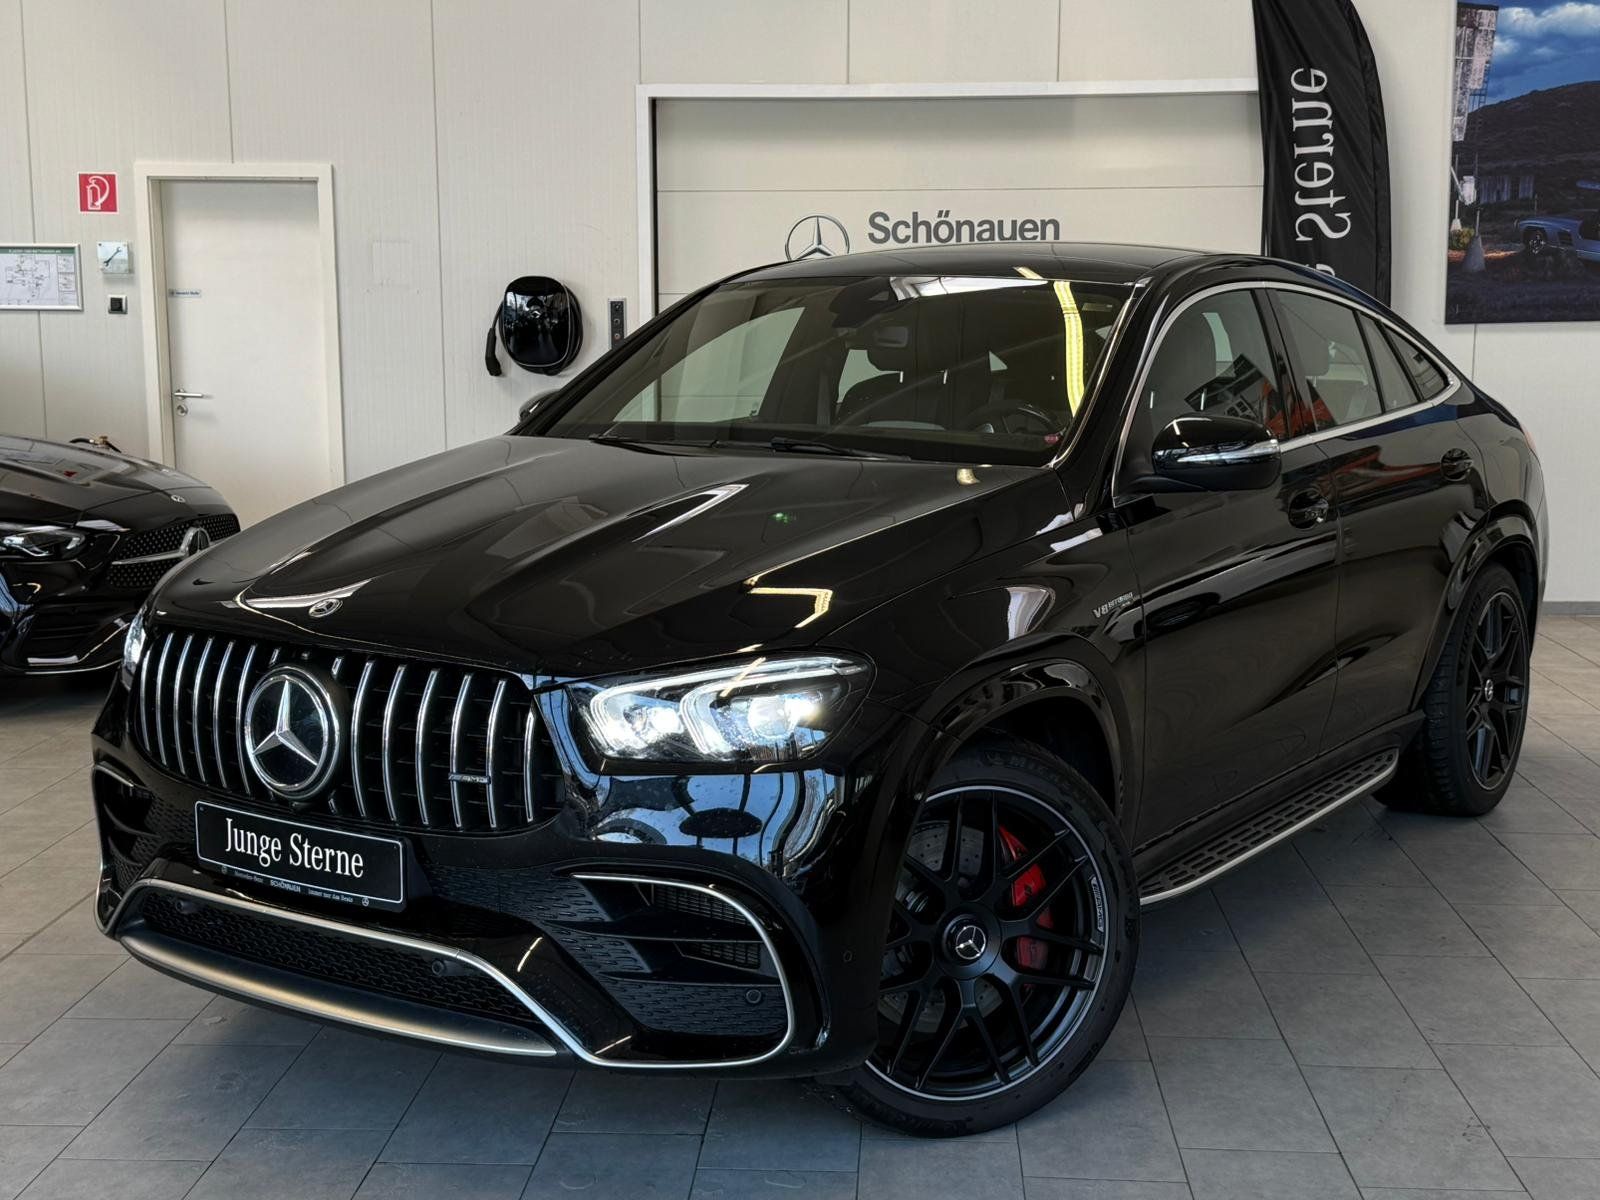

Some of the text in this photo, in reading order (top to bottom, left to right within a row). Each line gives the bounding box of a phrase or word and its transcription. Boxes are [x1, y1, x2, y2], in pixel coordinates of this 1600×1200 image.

[867, 209, 1061, 244] Schönauen
[225, 817, 364, 878] Junge Sterne
